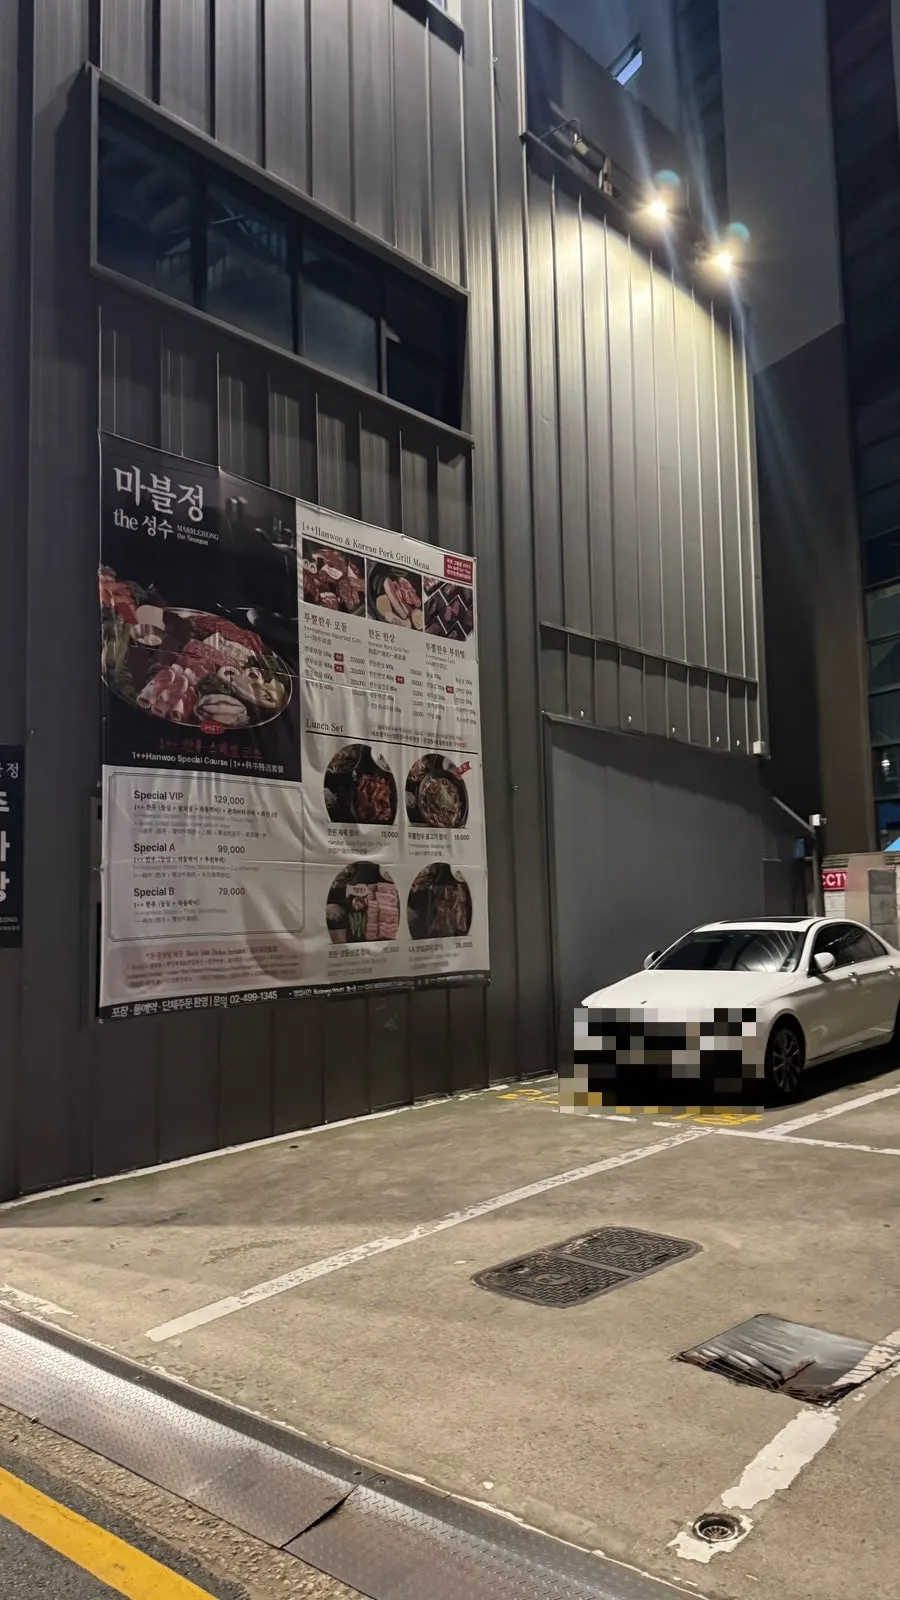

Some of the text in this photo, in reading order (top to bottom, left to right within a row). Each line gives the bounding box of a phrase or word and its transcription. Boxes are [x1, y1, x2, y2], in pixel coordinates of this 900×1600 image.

[113, 465, 204, 521] 마블정
[113, 509, 174, 540] the 성수
[302, 522, 430, 571] 1++Hanwoo & Korean Pork Grill Menu
[305, 719, 344, 732] Lunch Set
[132, 752, 176, 762] 1++Hanwoo
[177, 754, 203, 764] Special
[204, 757, 228, 767] Course
[134, 790, 245, 806] Special VIP 129,000
[133, 843, 246, 854] Special A 99,000
[133, 886, 246, 899] Special B 79,000
[111, 1006, 129, 1018] 포장
[162, 998, 193, 1012] 단체주문
[229, 991, 278, 1005] 02-499-1345
